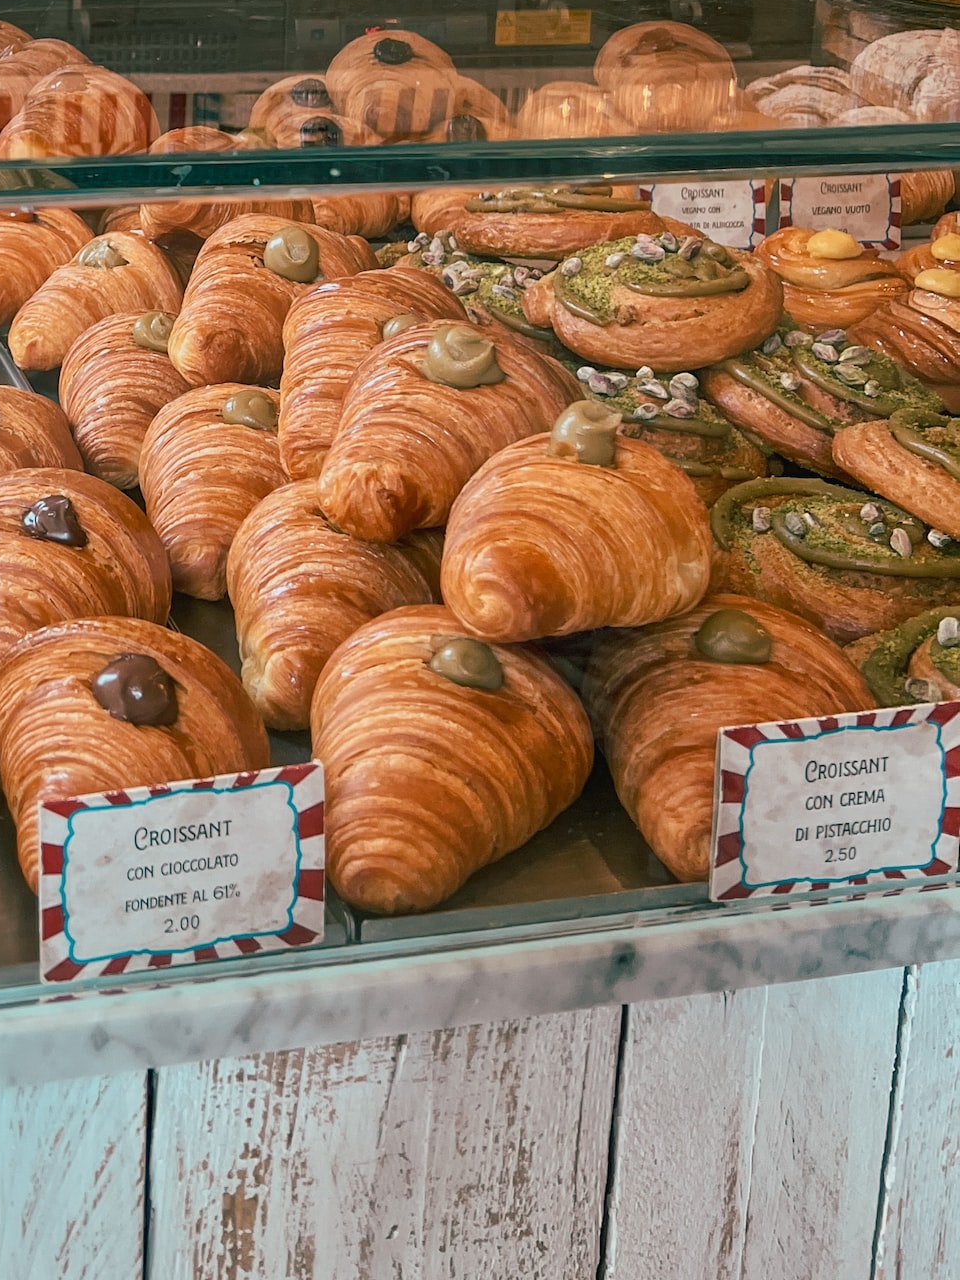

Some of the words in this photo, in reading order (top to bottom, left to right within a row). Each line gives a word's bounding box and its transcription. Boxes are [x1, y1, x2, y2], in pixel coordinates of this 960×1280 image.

[681, 187, 725, 201] CROISSANT
[820, 181, 863, 195] CROISSANT
[812, 206, 842, 216] VEGANO
[845, 204, 871, 214] VUOTO
[805, 756, 890, 783] CROISSANT
[805, 794, 834, 810] CON
[839, 789, 885, 807] CREMA
[134, 820, 233, 851] CROISSANT
[795, 826, 809, 841] DI
[815, 818, 892, 839] PISTACCHIO
[824, 846, 857, 863] 2.50
[127, 864, 155, 882] CON
[160, 853, 239, 877] CIOCCOLATO
[125, 892, 188, 913] FONDENTE
[192, 890, 209, 903] AL
[213, 883, 241, 901] 61%
[164, 915, 200, 933] 2.00
